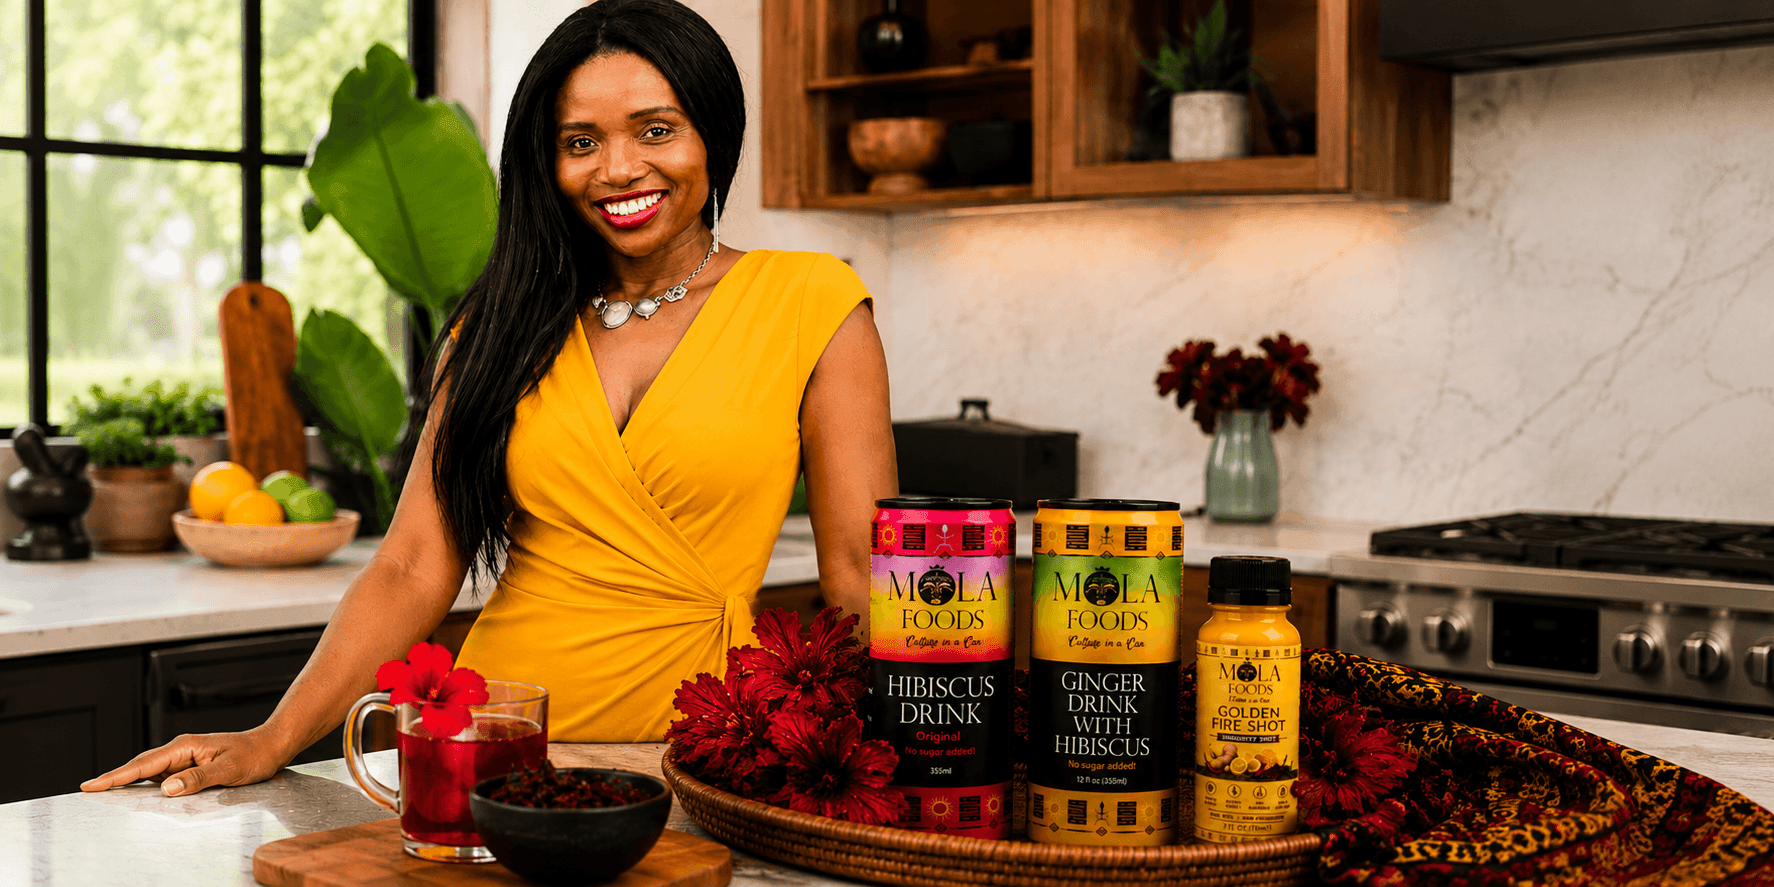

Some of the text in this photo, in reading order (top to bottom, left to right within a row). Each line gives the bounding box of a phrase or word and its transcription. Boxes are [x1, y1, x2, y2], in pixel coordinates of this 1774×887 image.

[902, 609, 984, 629] FOODS
[1067, 609, 1148, 631] FOODS
[1105, 638, 1113, 647] in
[888, 675, 994, 698] HIBISCUS
[1061, 671, 1146, 692] GINGER
[1229, 683, 1273, 695] FOODS
[1067, 693, 1138, 713] DRINK
[900, 702, 981, 724] DRINK
[1218, 705, 1279, 718] GOLDEN
[1073, 715, 1131, 734] WITH
[1212, 717, 1286, 732] FIRE SHOT
[916, 731, 961, 744] Original
[905, 747, 975, 757] No sugar added!
[1055, 735, 1150, 757] HIBISCUS
[930, 767, 952, 775] 355ml
[1068, 760, 1136, 771] No sugar added!
[1101, 777, 1127, 785] (355ml)
